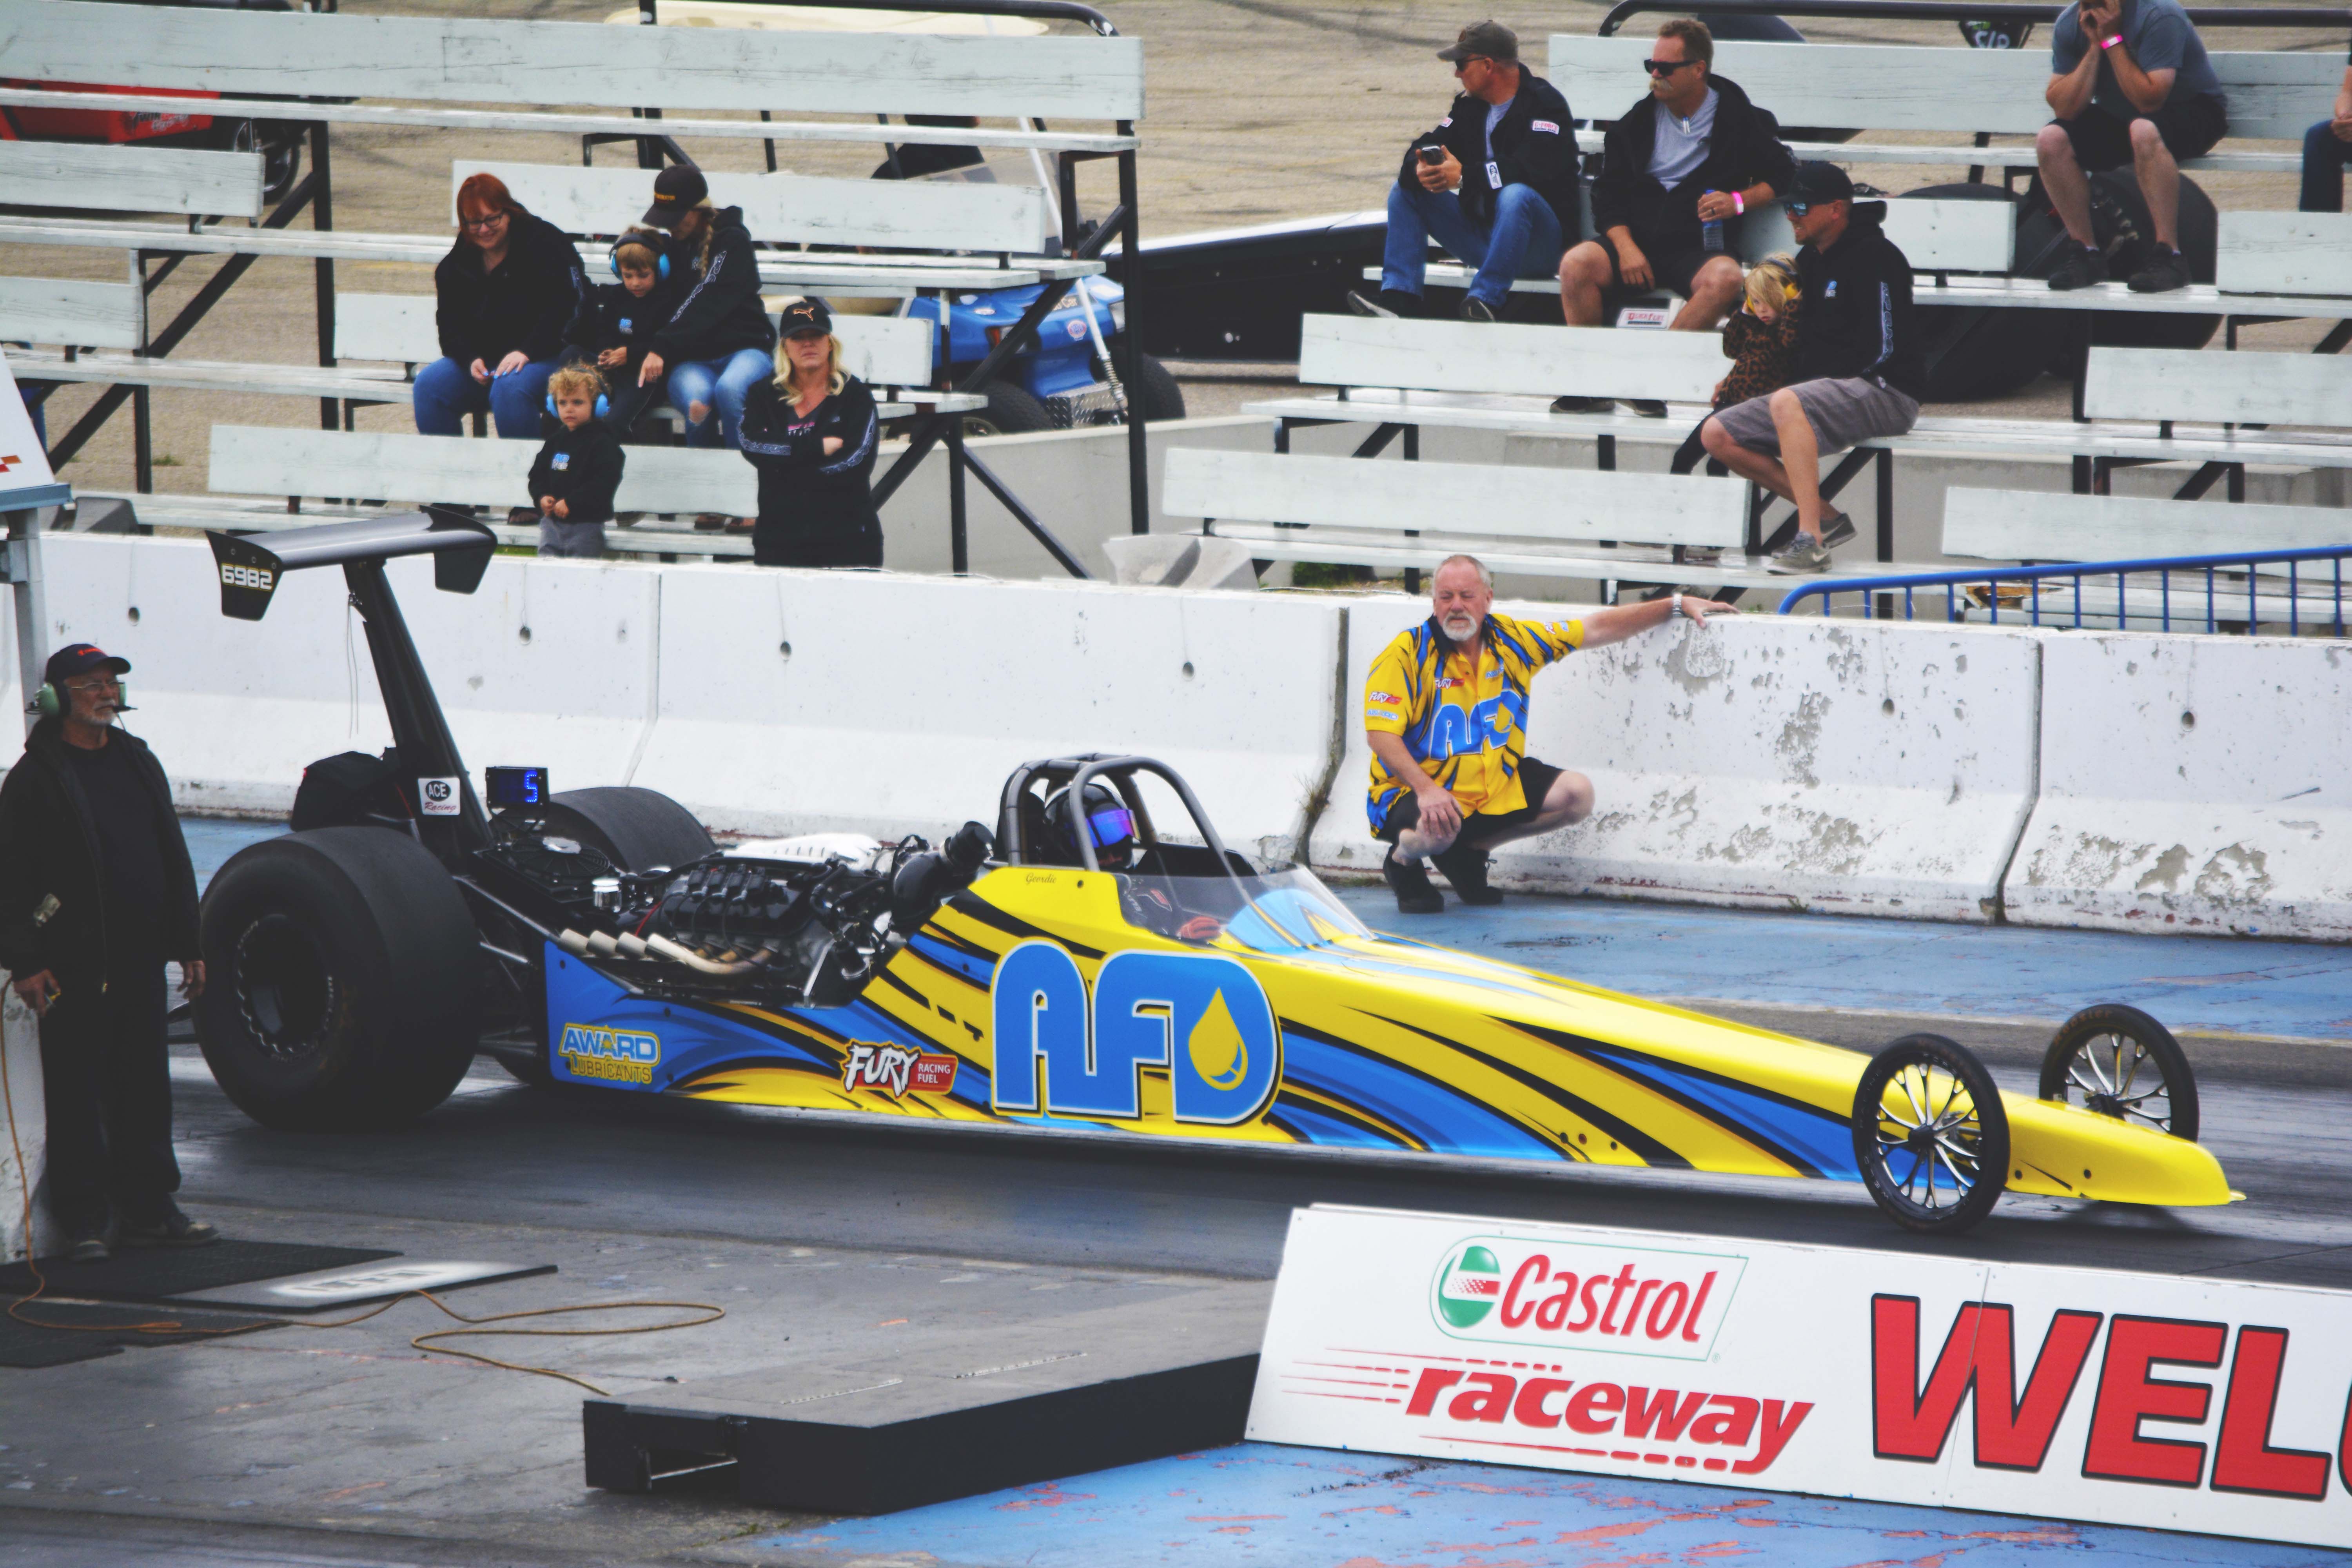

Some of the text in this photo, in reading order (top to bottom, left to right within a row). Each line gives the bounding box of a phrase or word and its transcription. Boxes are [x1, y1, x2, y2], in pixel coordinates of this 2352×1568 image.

[222, 564, 273, 591] 6982
[428, 784, 447, 798] ACE
[524, 770, 538, 803] 5
[424, 802, 457, 813] Racing
[561, 1027, 659, 1064] AWARD
[992, 940, 1279, 1125] AFD
[571, 1056, 651, 1082] LUBRICANTS
[845, 1045, 919, 1097] FURY
[918, 1063, 951, 1074] RACING
[918, 1074, 938, 1084] FUEL
[1500, 1254, 1719, 1343] Castrol
[1871, 1292, 2352, 1502] WEL
[1405, 1367, 1816, 1475] raceway
